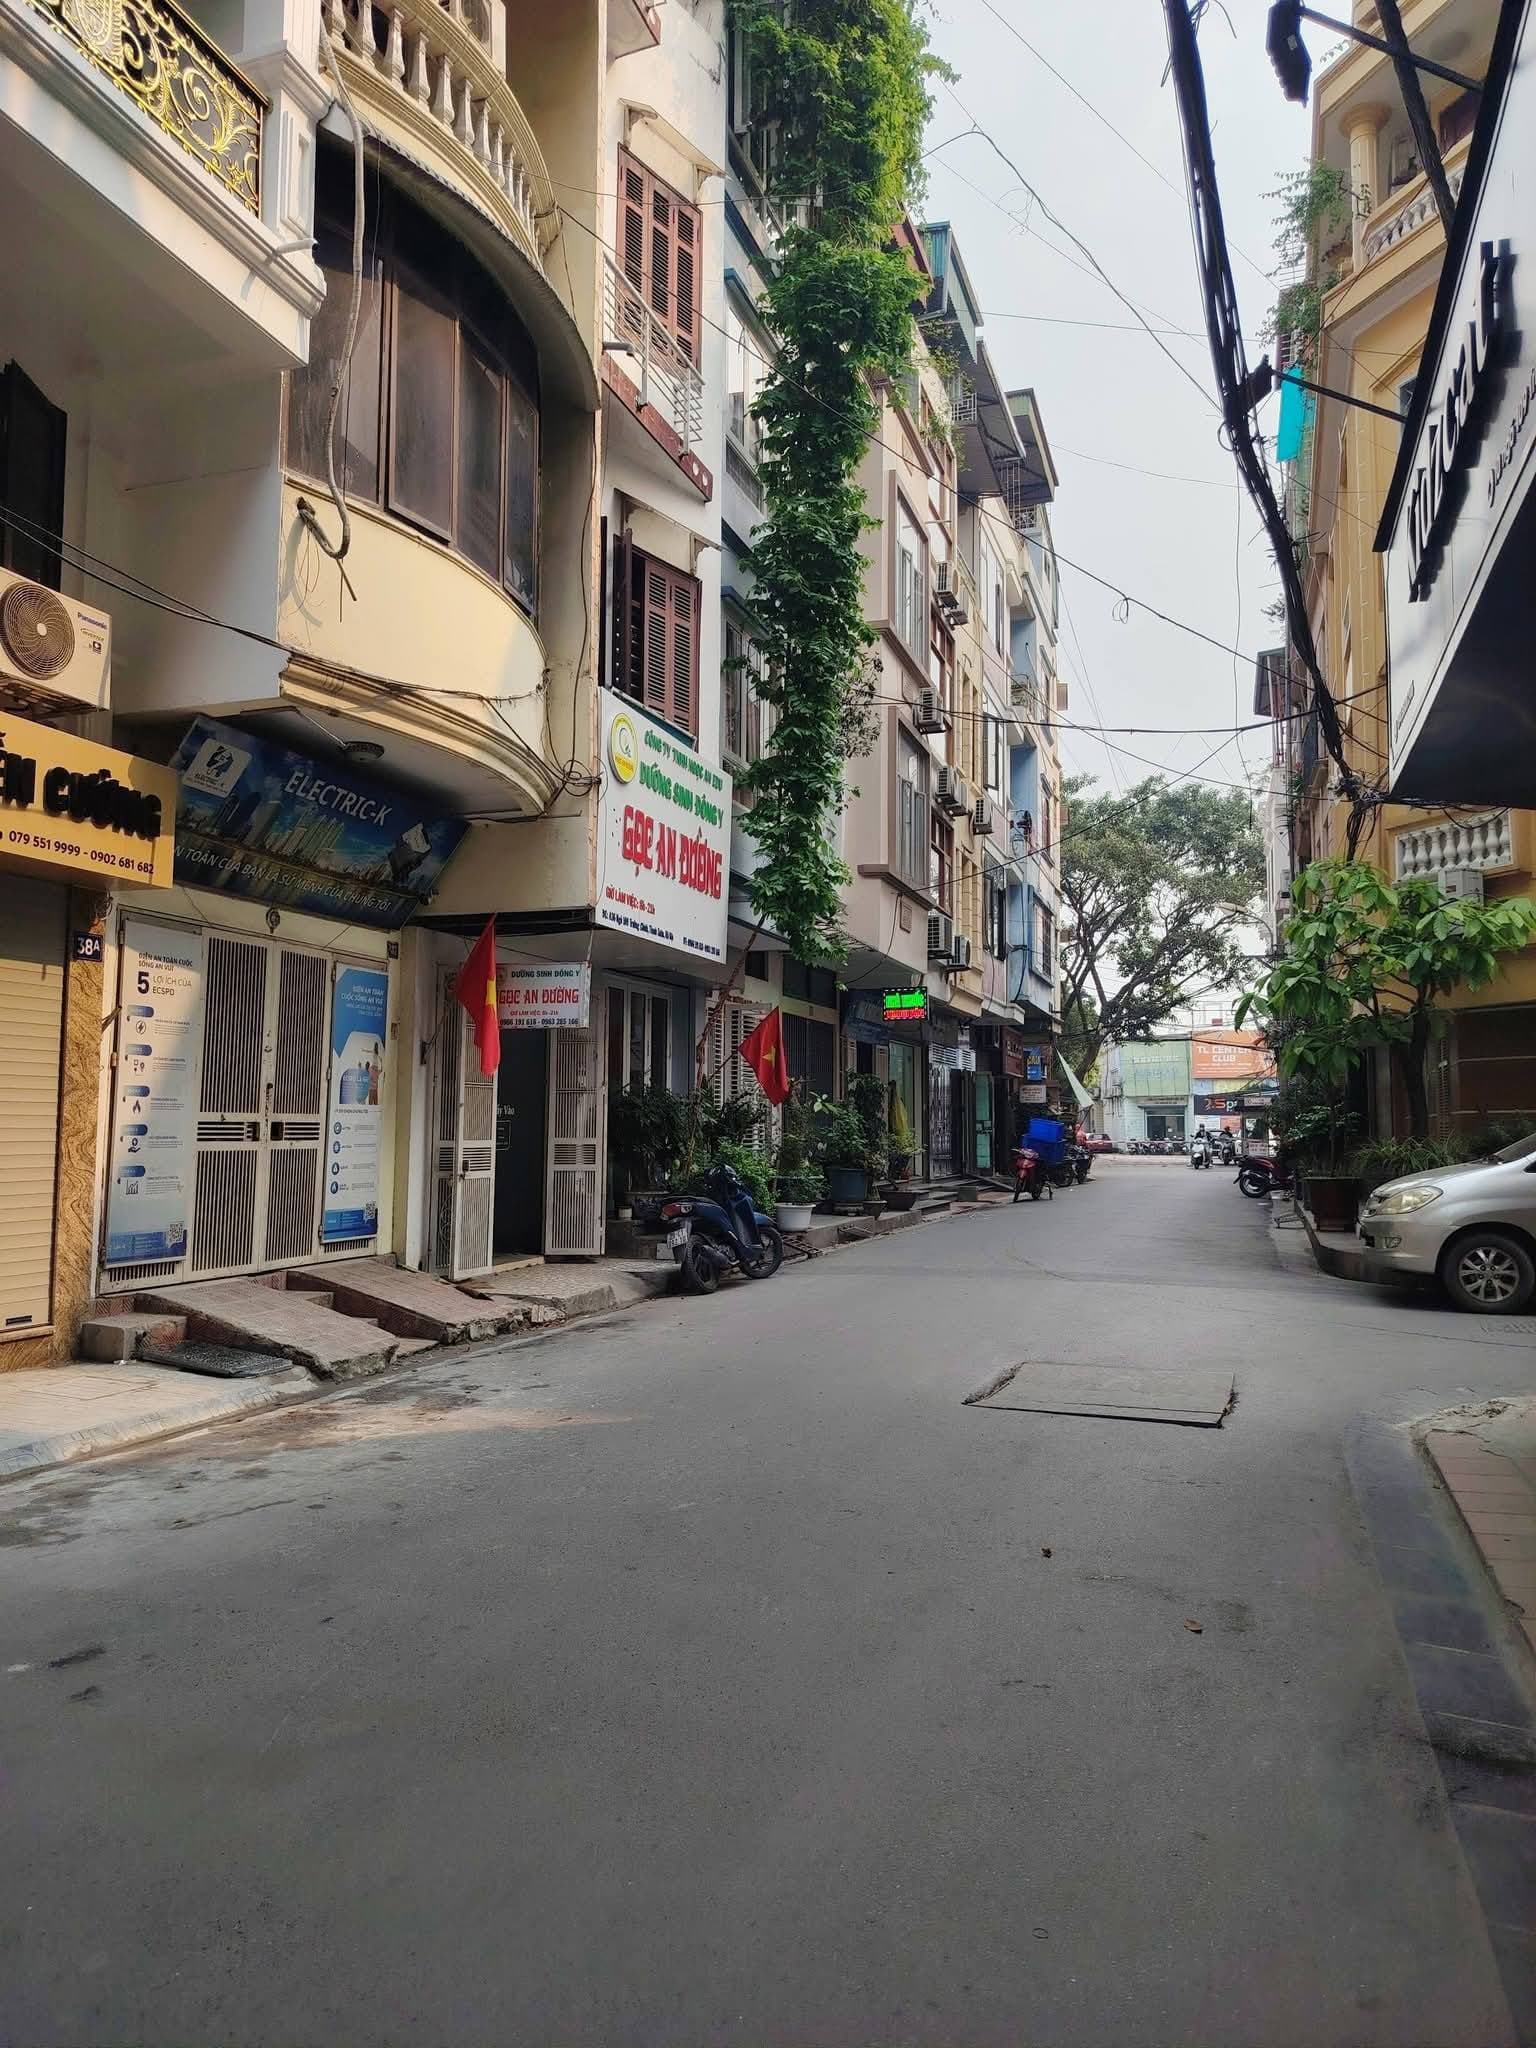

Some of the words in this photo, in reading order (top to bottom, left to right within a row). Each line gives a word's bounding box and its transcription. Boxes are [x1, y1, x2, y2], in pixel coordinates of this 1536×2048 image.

[284, 770, 393, 827] ELECTRIC-K
[672, 782, 693, 812] SINH
[717, 808, 724, 829] Y
[9, 830, 31, 845] 079
[33, 834, 51, 850] 551
[54, 841, 81, 857] 9999
[90, 850, 116, 865] 0902
[118, 856, 135, 870] 681
[137, 861, 155, 874] 682
[655, 822, 677, 880] AN
[77, 936, 100, 956] 38A
[137, 970, 150, 994] 5
[536, 970, 553, 978] SINH
[524, 989, 539, 1004] AN
